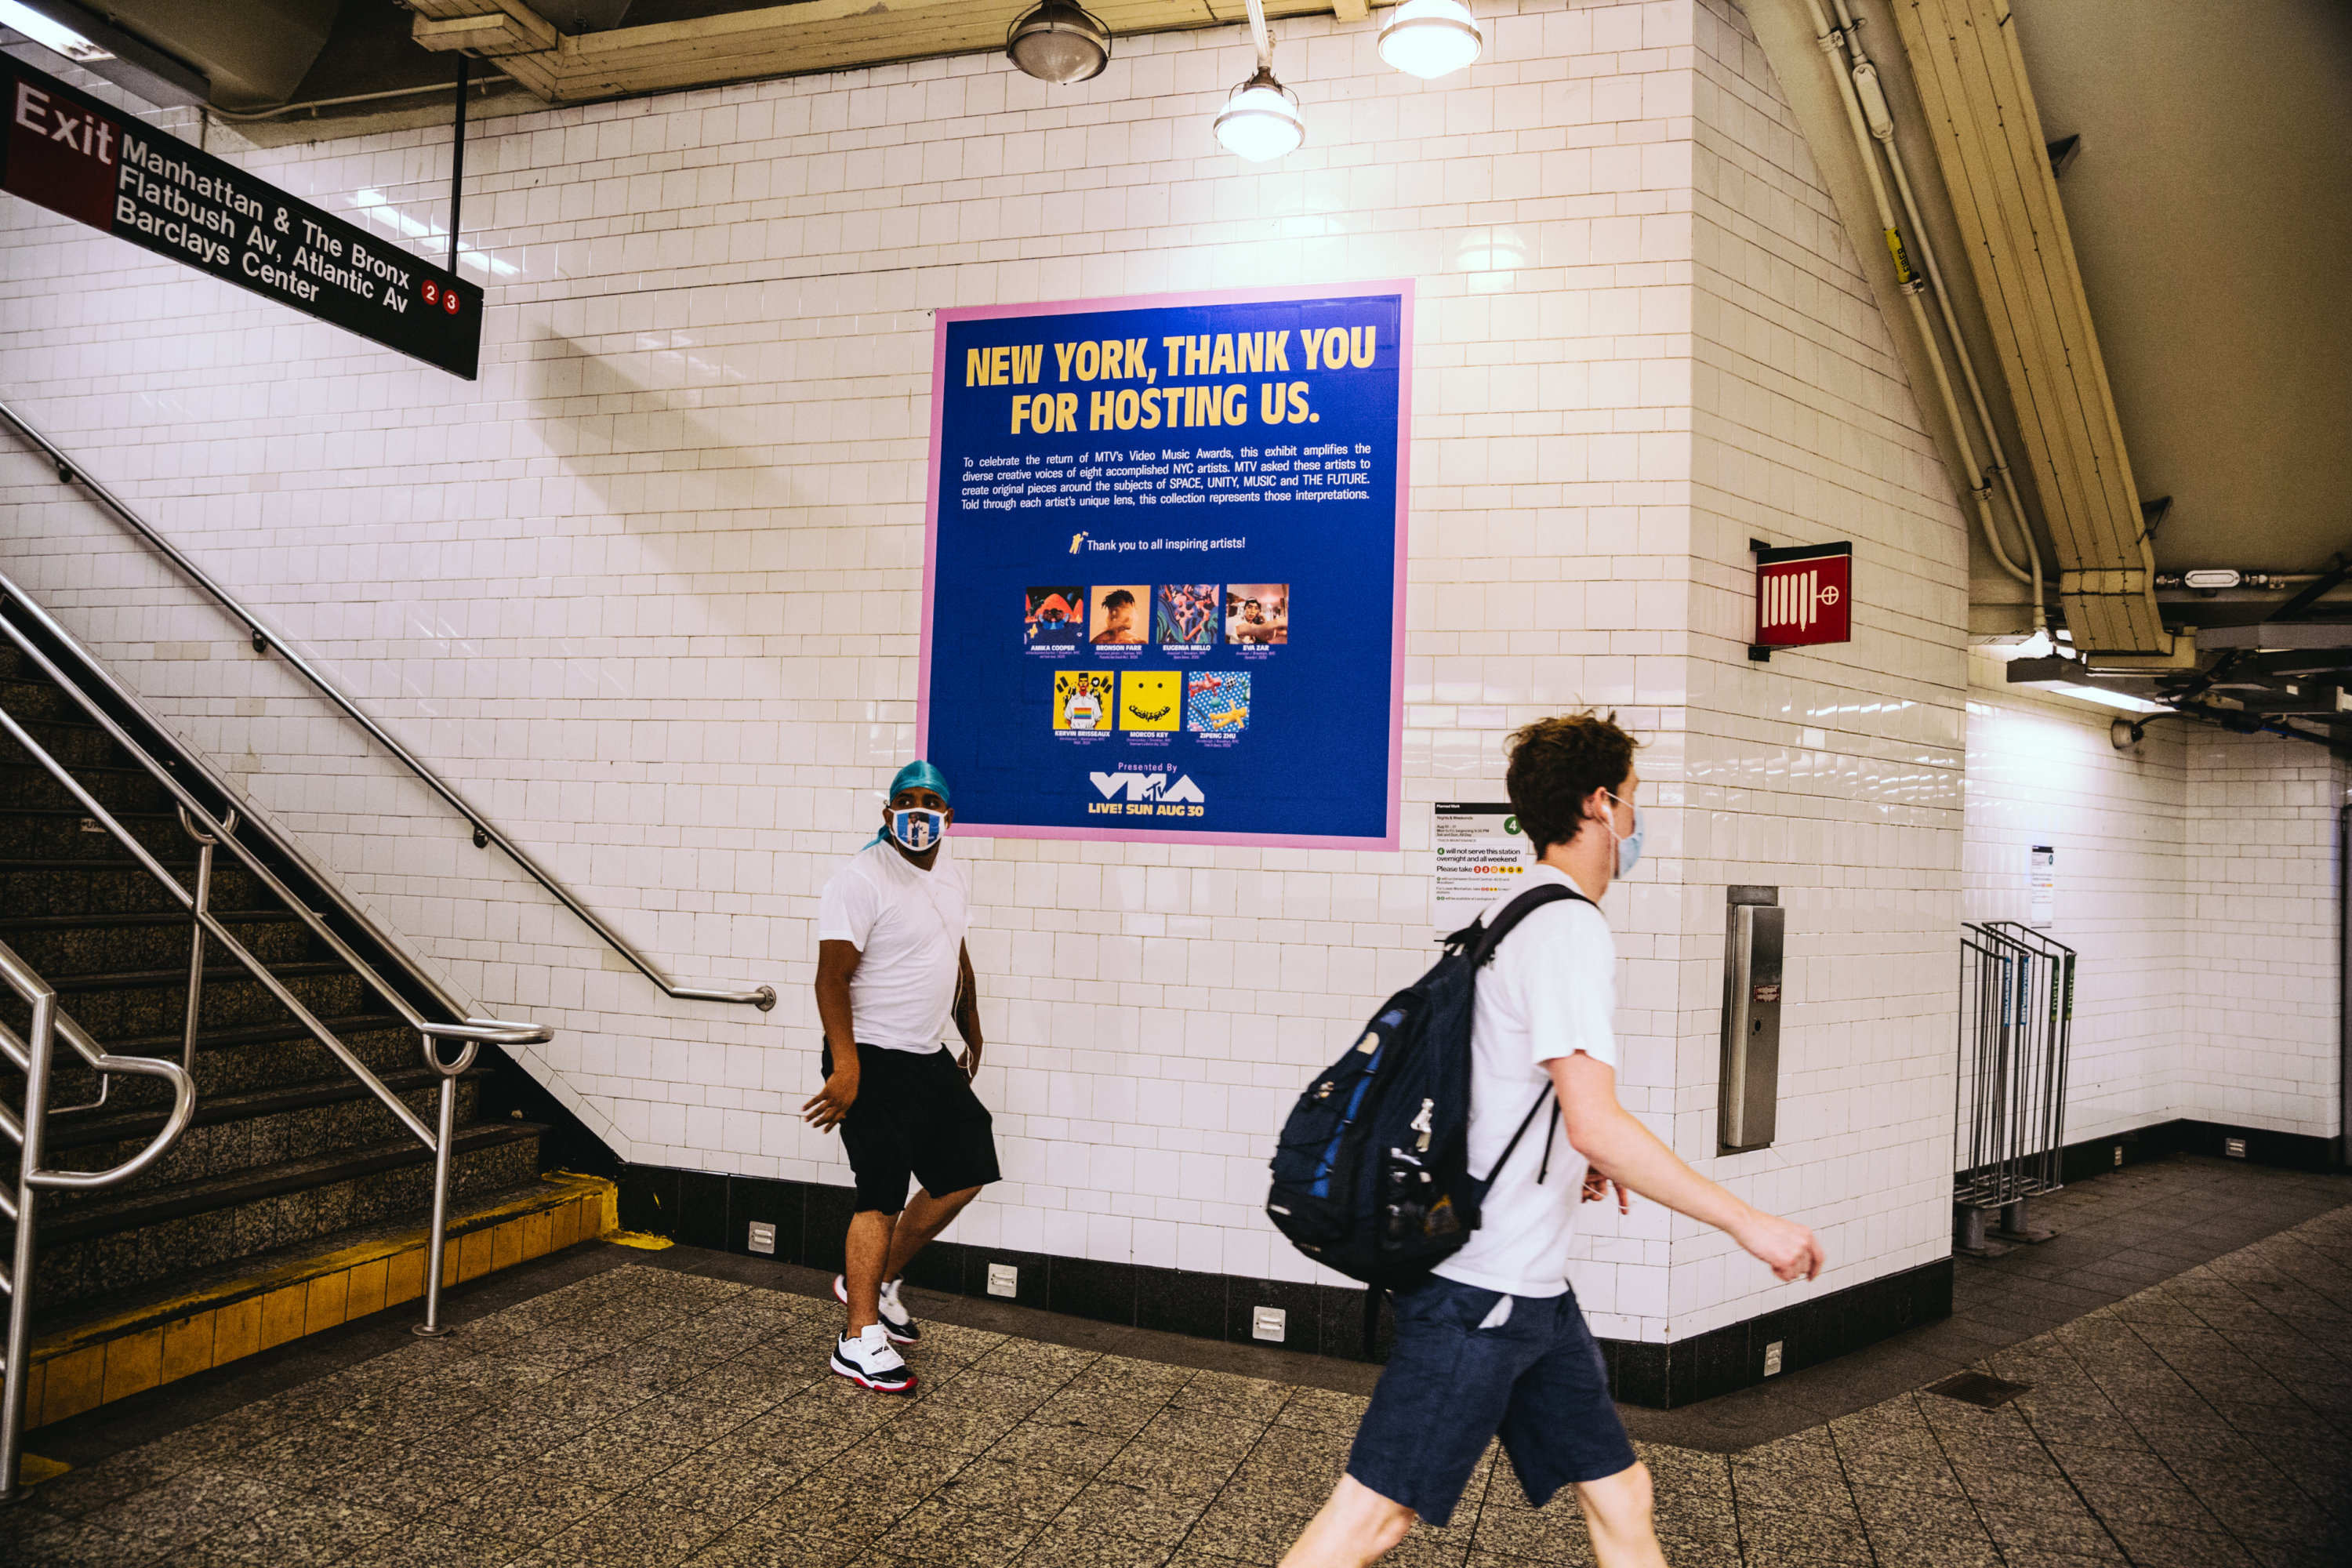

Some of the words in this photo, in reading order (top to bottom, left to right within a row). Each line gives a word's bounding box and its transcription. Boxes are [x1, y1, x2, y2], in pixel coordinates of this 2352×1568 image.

[16, 82, 112, 165] Exit
[122, 133, 263, 222] Manhattan
[274, 207, 290, 234] &
[302, 219, 343, 257] The
[351, 243, 410, 290] Bronx
[116, 194, 230, 267] Barclays
[241, 251, 320, 303] Center
[119, 164, 235, 238] Flatbush
[246, 225, 281, 263] Av,
[292, 247, 374, 299] Atlantic
[383, 287, 408, 313] Av
[967, 345, 1043, 387] NEW
[1054, 339, 1156, 384] YORK,
[1163, 331, 1290, 376] THANK
[1300, 325, 1376, 370] YOU
[1011, 393, 1078, 434] FOR
[1090, 384, 1247, 430] HOSTING
[1261, 381, 1319, 424] US.
[963, 456, 974, 468] To
[978, 456, 1020, 467] celebrate
[1025, 454, 1040, 465] the
[1046, 454, 1073, 465] return
[1079, 452, 1089, 463] of
[1129, 449, 1156, 462] Video
[1161, 448, 1191, 460] Music
[1196, 446, 1234, 460] Awards,
[1240, 446, 1258, 458] this
[1265, 445, 1298, 457] exhibit
[1303, 443, 1348, 458] amplifies
[1354, 442, 1371, 455] the
[962, 470, 994, 482] diverse
[996, 469, 1033, 481] creative
[1034, 468, 1064, 479] voices
[1066, 466, 1076, 478] of
[1080, 466, 1103, 480] eight
[1105, 463, 1169, 478] accomplished
[1173, 462, 1194, 474] NYC
[1197, 462, 1230, 474] artists.
[1234, 460, 1258, 473] MTV
[1260, 459, 1290, 472] asked
[1293, 459, 1321, 471] these
[1324, 458, 1357, 470] artists
[1359, 458, 1371, 470] to
[961, 485, 989, 496] create
[992, 482, 1025, 497] original
[1027, 482, 1057, 496] pieces
[1059, 481, 1092, 493] around
[1095, 480, 1111, 492] the
[1113, 479, 1153, 493] subjects
[1156, 477, 1167, 490] of
[1169, 477, 1203, 490] SPACE,
[1207, 476, 1240, 489] UNITY,
[1243, 474, 1277, 487] MUSIC
[1279, 474, 1299, 487] and
[1302, 474, 1323, 485] THE
[1327, 472, 1370, 485] FUTURE.
[960, 499, 979, 510] Told
[982, 497, 1017, 511] through
[1019, 496, 1042, 508] each
[1079, 495, 1111, 509] unique
[1113, 494, 1136, 506] lens,
[1139, 493, 1157, 505] this
[1160, 492, 1206, 504] collection
[1209, 492, 1261, 506] represents
[1263, 490, 1292, 502] those
[1295, 488, 1370, 503] interpretations.
[1086, 539, 1117, 551] Thank
[1118, 542, 1136, 553] you
[1138, 539, 1149, 550] to
[1150, 538, 1163, 550] all
[1165, 538, 1209, 552] inspiring
[1210, 536, 1246, 549] artists!
[1118, 762, 1163, 771] Presented
[1167, 763, 1178, 773] By
[1088, 802, 1123, 814] LIVE!
[1126, 804, 1153, 815] SUN
[1156, 804, 1185, 816] AUG
[1187, 806, 1204, 816] 30
